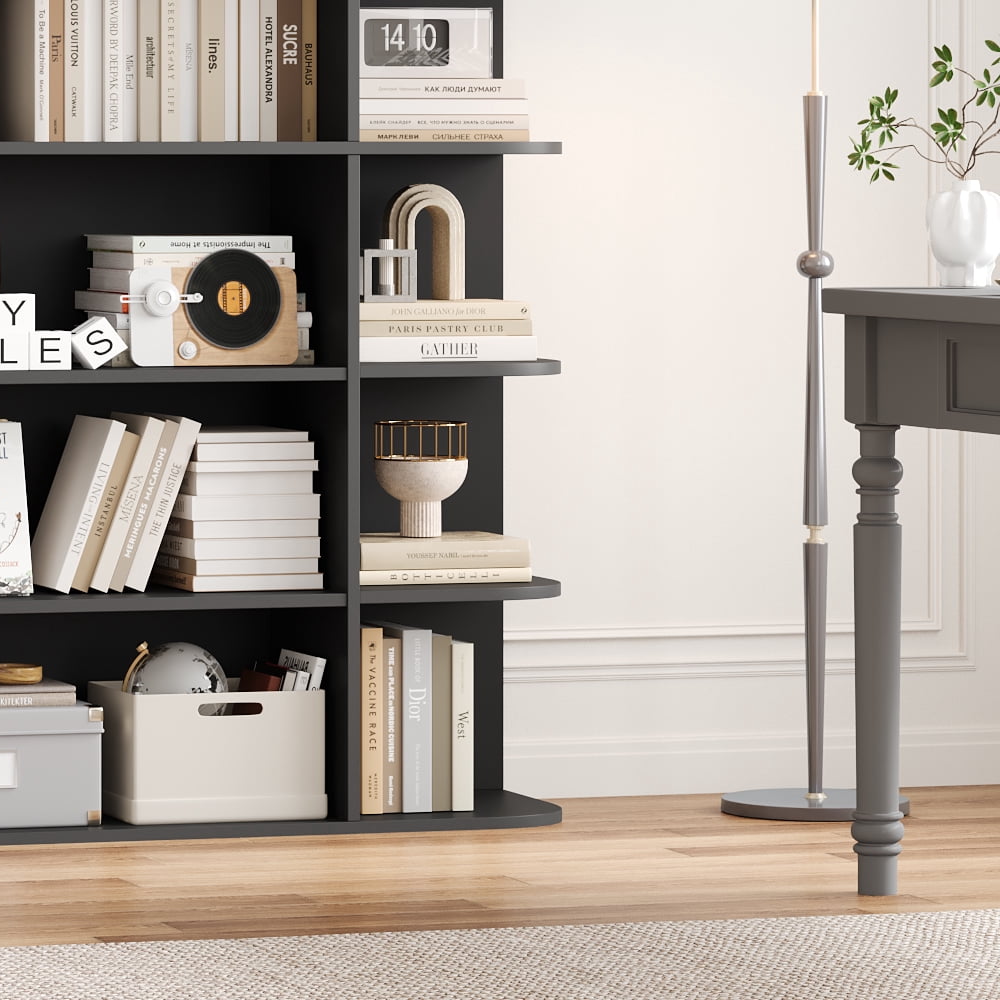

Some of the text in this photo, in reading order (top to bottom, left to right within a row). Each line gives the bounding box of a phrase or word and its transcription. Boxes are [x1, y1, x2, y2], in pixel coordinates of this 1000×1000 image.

[52, 35, 62, 63] Paris
[71, 0, 79, 67] LOUIS VUITTON
[110, 39, 119, 51] BY
[283, 24, 298, 65] SUCRE
[381, 23, 437, 52] 14 10
[208, 38, 220, 74] lines.
[265, 17, 273, 103] HOTEL ALEXANDRA
[305, 43, 313, 86] BAUHAUS
[110, 54, 119, 90] DEEPAK
[126, 74, 134, 90] End
[442, 86, 466, 94] ЛЮДИ
[468, 86, 502, 94] ДУМАЮТ
[110, 92, 119, 132] CHOPRA
[432, 133, 504, 141] СИЛЬНЕЕ СТРАХА
[203, 240, 256, 249] Impressionists
[258, 240, 271, 249] The
[389, 325, 504, 334] PARIS PASTRY CLUB
[420, 342, 478, 356] GATHER
[95, 485, 118, 537] INSTANBUL
[124, 447, 167, 559] MERINGUES MACARONS
[149, 462, 182, 537] THE THIN JUSTICE
[368, 667, 377, 716] VACCINE
[409, 688, 427, 722] Dior
[368, 723, 377, 752] RACE
[457, 711, 469, 740] West
